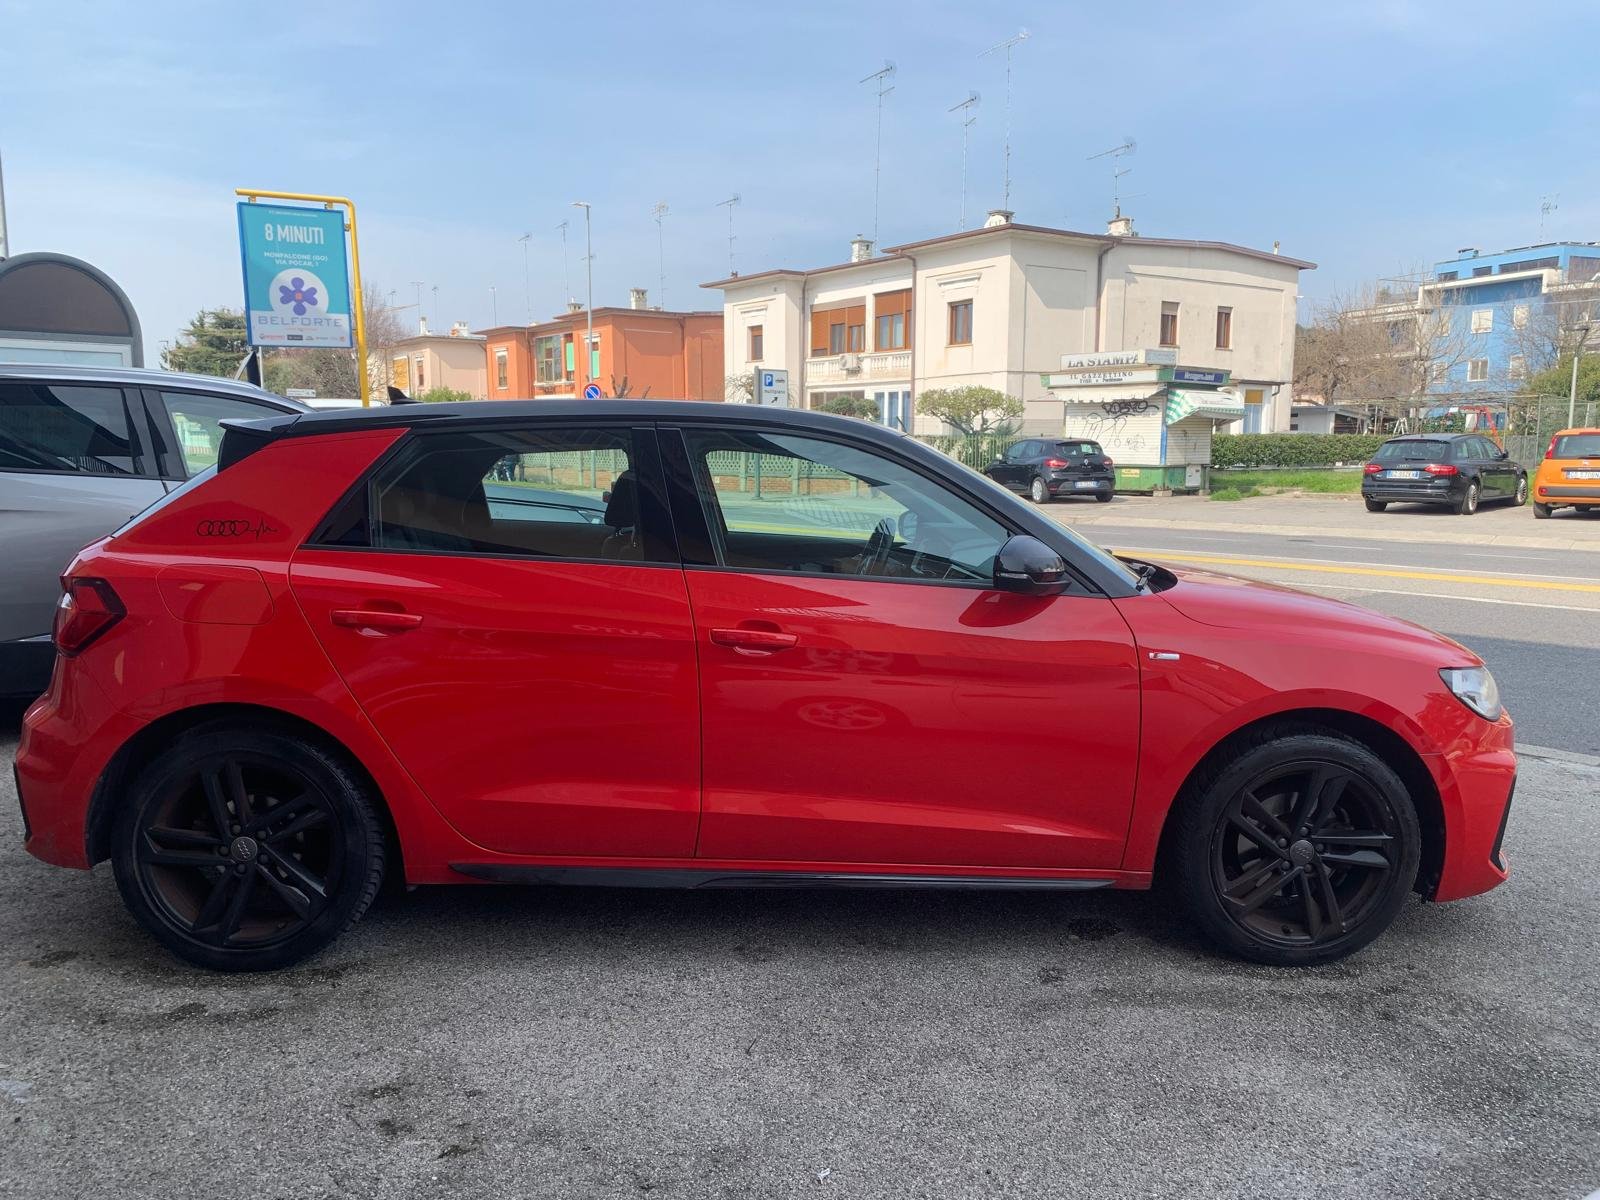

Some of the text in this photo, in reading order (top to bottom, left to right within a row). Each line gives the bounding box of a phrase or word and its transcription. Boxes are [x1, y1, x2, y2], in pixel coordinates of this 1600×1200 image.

[265, 223, 325, 245] 8 MINUTI
[258, 315, 343, 328] BELFORTE
[765, 375, 772, 386] P
[1081, 371, 1134, 379] GAZZETTINO
